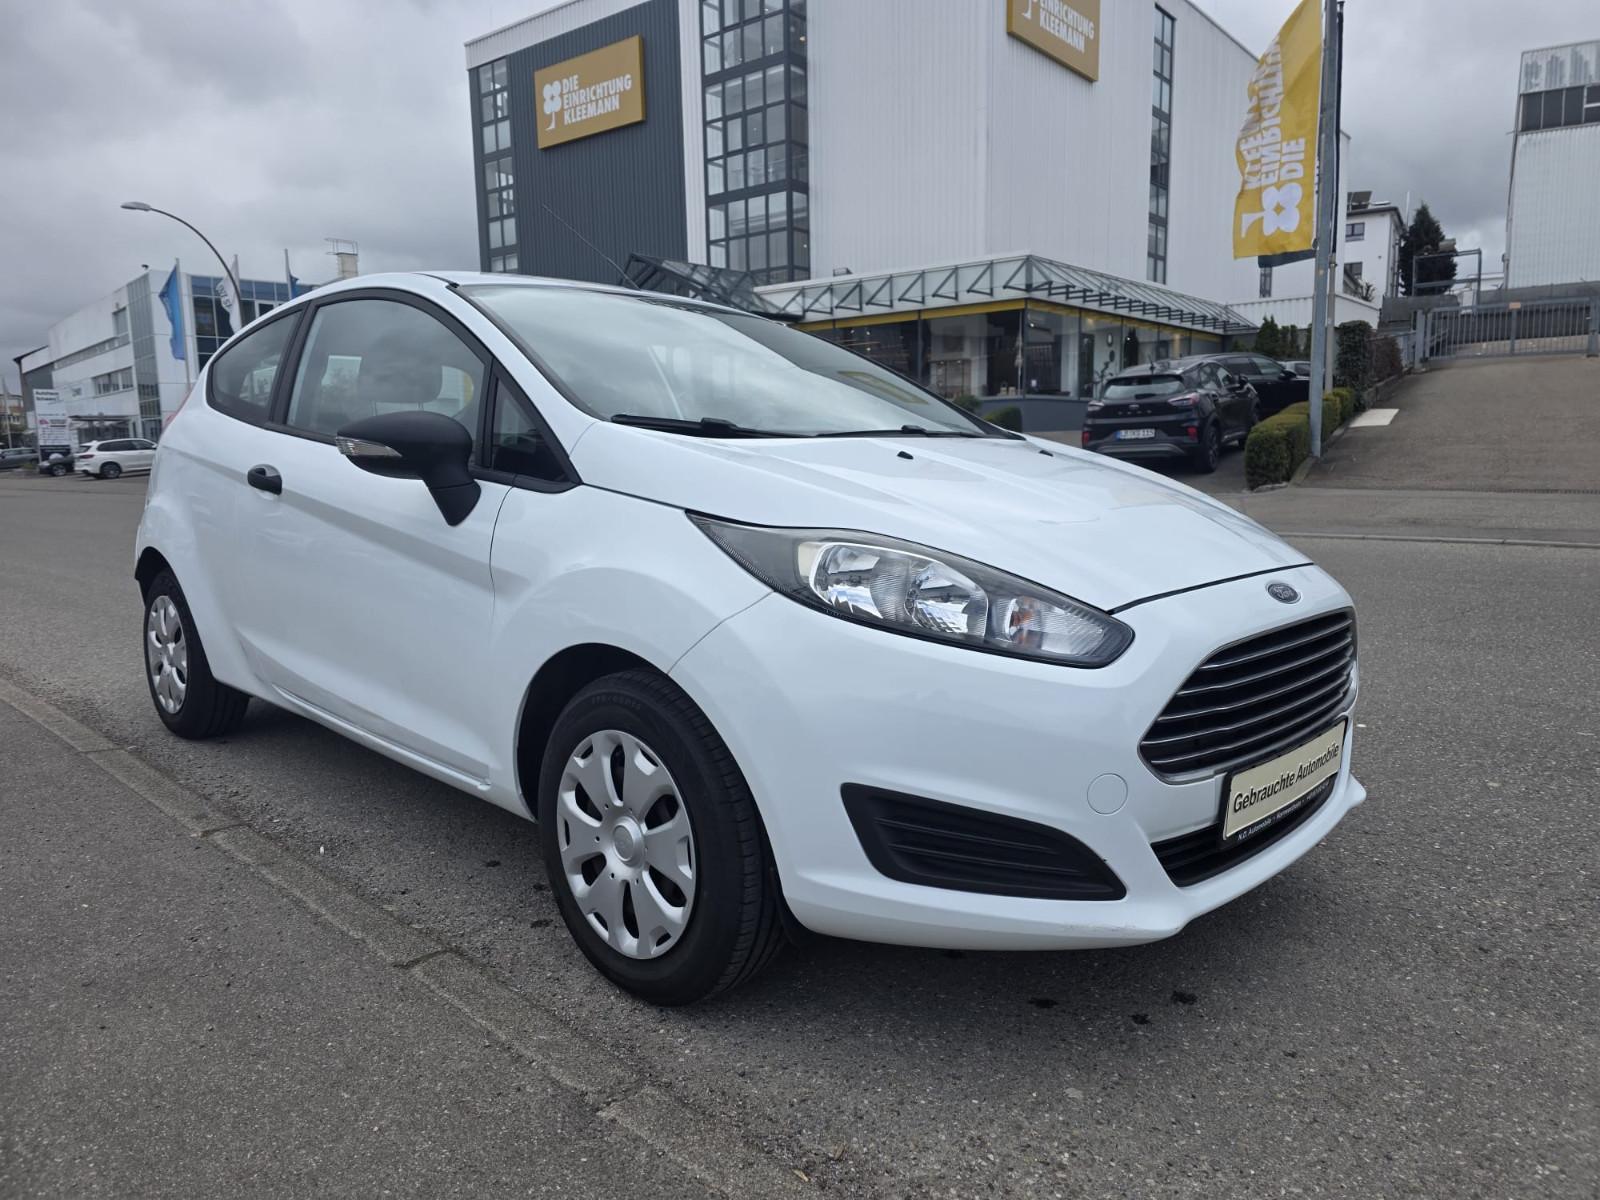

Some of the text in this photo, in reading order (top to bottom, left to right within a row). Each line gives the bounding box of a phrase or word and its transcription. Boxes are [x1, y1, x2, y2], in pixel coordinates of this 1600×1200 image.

[1040, 8, 1085, 54] KLEEMANN
[562, 75, 579, 94] DIE
[563, 74, 632, 109] EINRICHTUNG
[564, 94, 620, 125] KLEEMANN
[1233, 772, 1295, 813] Gebrauchte
[1295, 743, 1339, 783] Automobile
